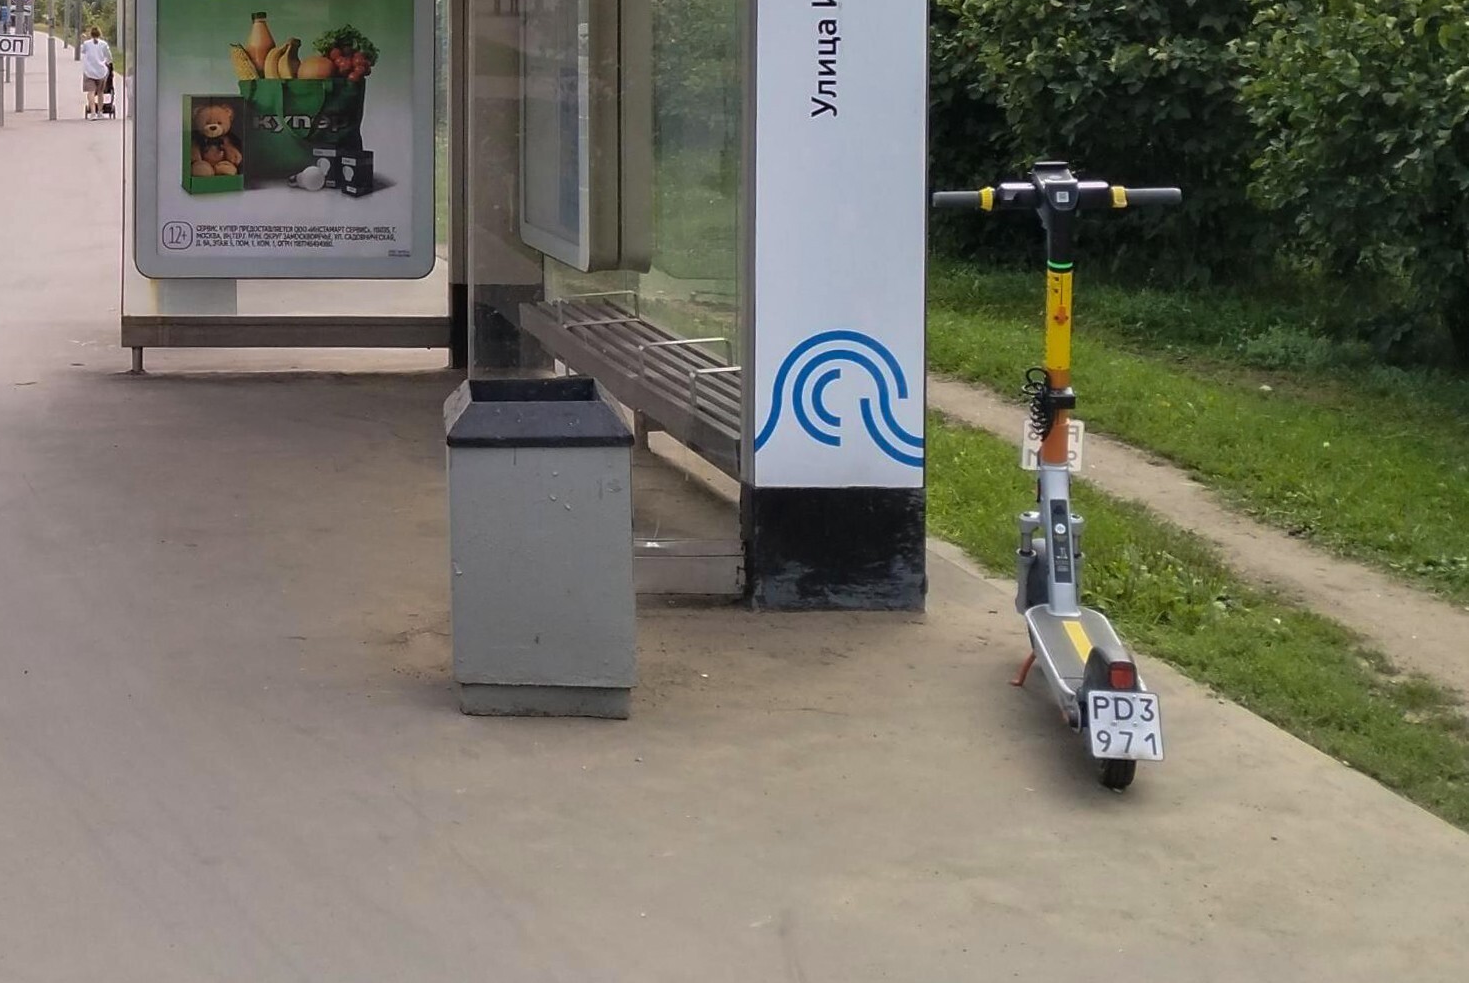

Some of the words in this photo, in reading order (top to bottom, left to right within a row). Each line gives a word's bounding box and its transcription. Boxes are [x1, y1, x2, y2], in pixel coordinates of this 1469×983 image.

[811, 19, 841, 117] Улица
[169, 225, 188, 245] 12+
[1093, 696, 1155, 722] PD3
[1096, 730, 1157, 756] 971
